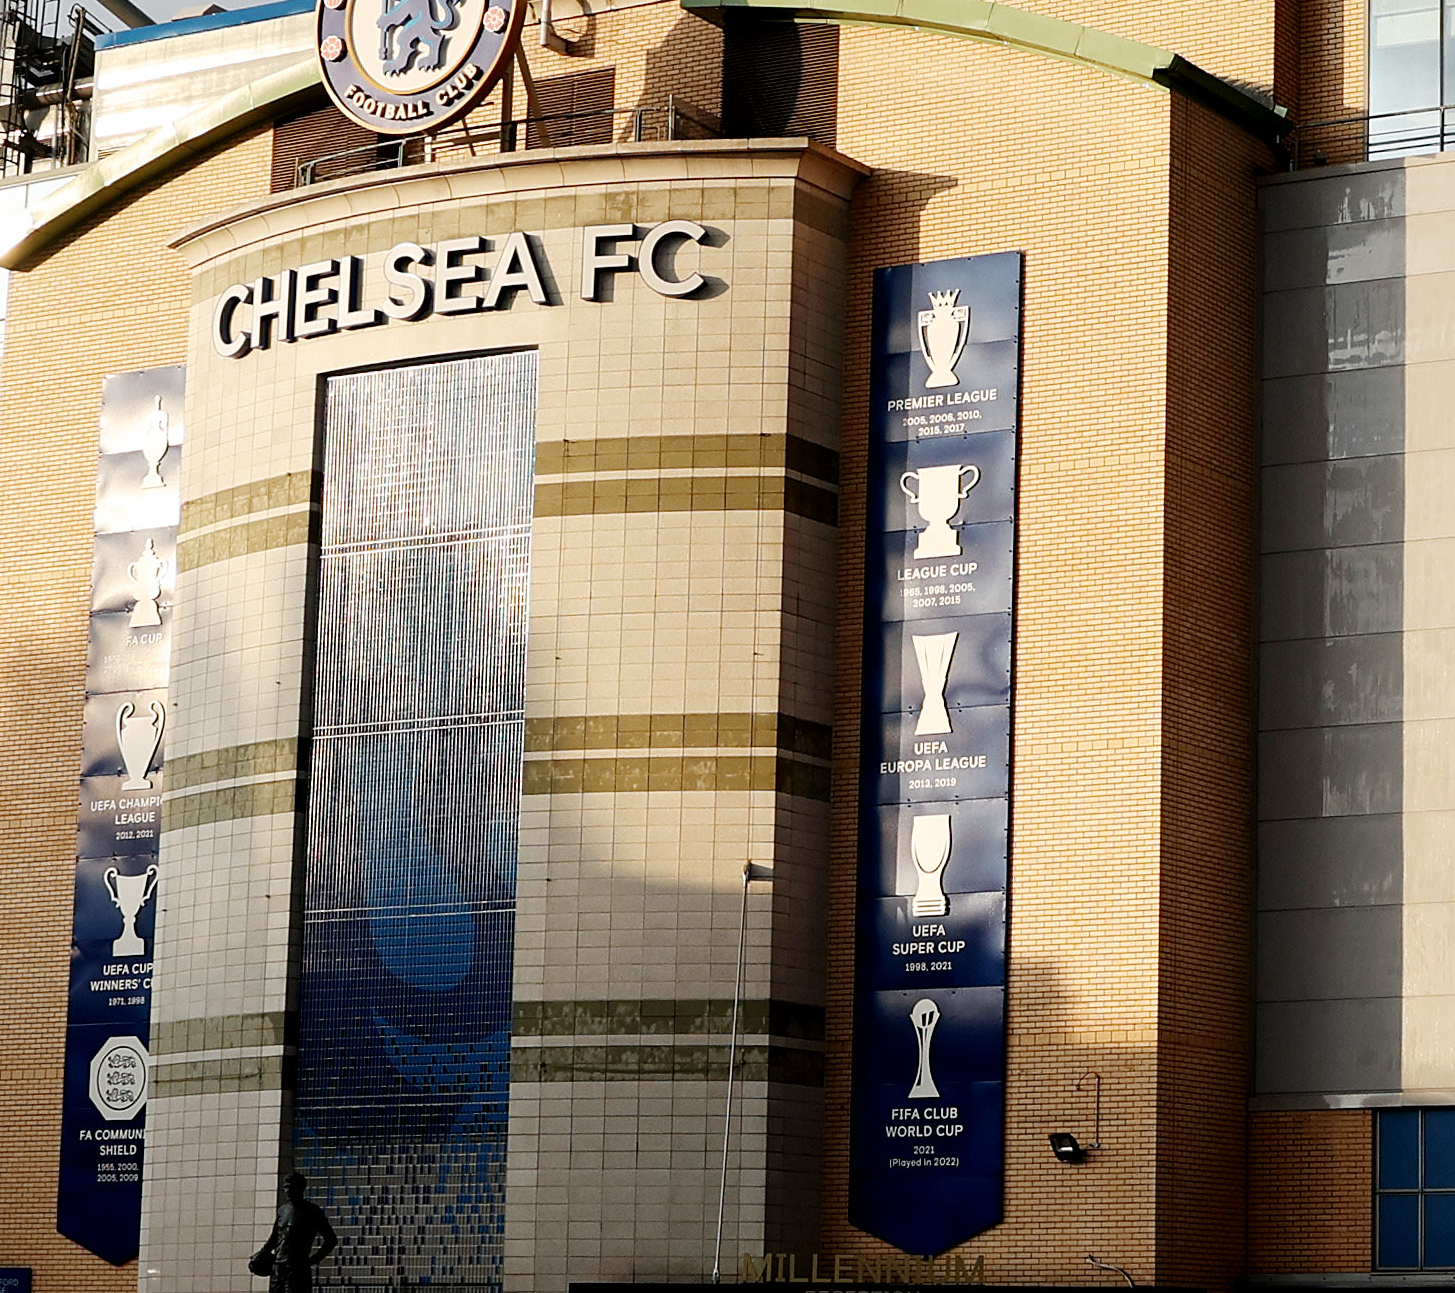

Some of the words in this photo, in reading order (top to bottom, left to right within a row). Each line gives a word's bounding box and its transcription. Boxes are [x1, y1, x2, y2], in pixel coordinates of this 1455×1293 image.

[344, 83, 428, 120] FOOTBALL
[435, 63, 480, 105] CLUB
[212, 232, 549, 360] CHELSEA
[580, 219, 709, 302] FC
[887, 394, 944, 412] PREMIER
[947, 389, 997, 406] LEAGUE
[897, 565, 947, 581] LEAGUE
[949, 562, 978, 576] CUP
[126, 635, 139, 647] FA
[141, 632, 163, 644] CUP
[914, 741, 948, 755] UEFA
[880, 759, 932, 774] EUROPA
[935, 755, 986, 771] LEAGUE
[90, 799, 116, 812] UEFA
[115, 812, 155, 825] LEAGUE
[913, 925, 945, 937] UEFA
[892, 942, 934, 955] SUPER
[938, 940, 966, 953] CUP
[103, 964, 129, 976] UEFA
[931, 961, 952, 970] 2021
[90, 978, 141, 991] WINNERS'
[891, 1108, 920, 1120] FIFA
[924, 1107, 958, 1119] CLUB
[79, 1130, 92, 1140] FA
[885, 1125, 932, 1137] WORLD
[936, 1124, 963, 1137] CUP
[99, 1145, 137, 1156] SHIELD
[913, 1146, 935, 1154] 2021
[889, 1158, 921, 1168] (Played
[933, 1157, 959, 1167] 2022)
[742, 1252, 985, 1286] MILLENNIUM
